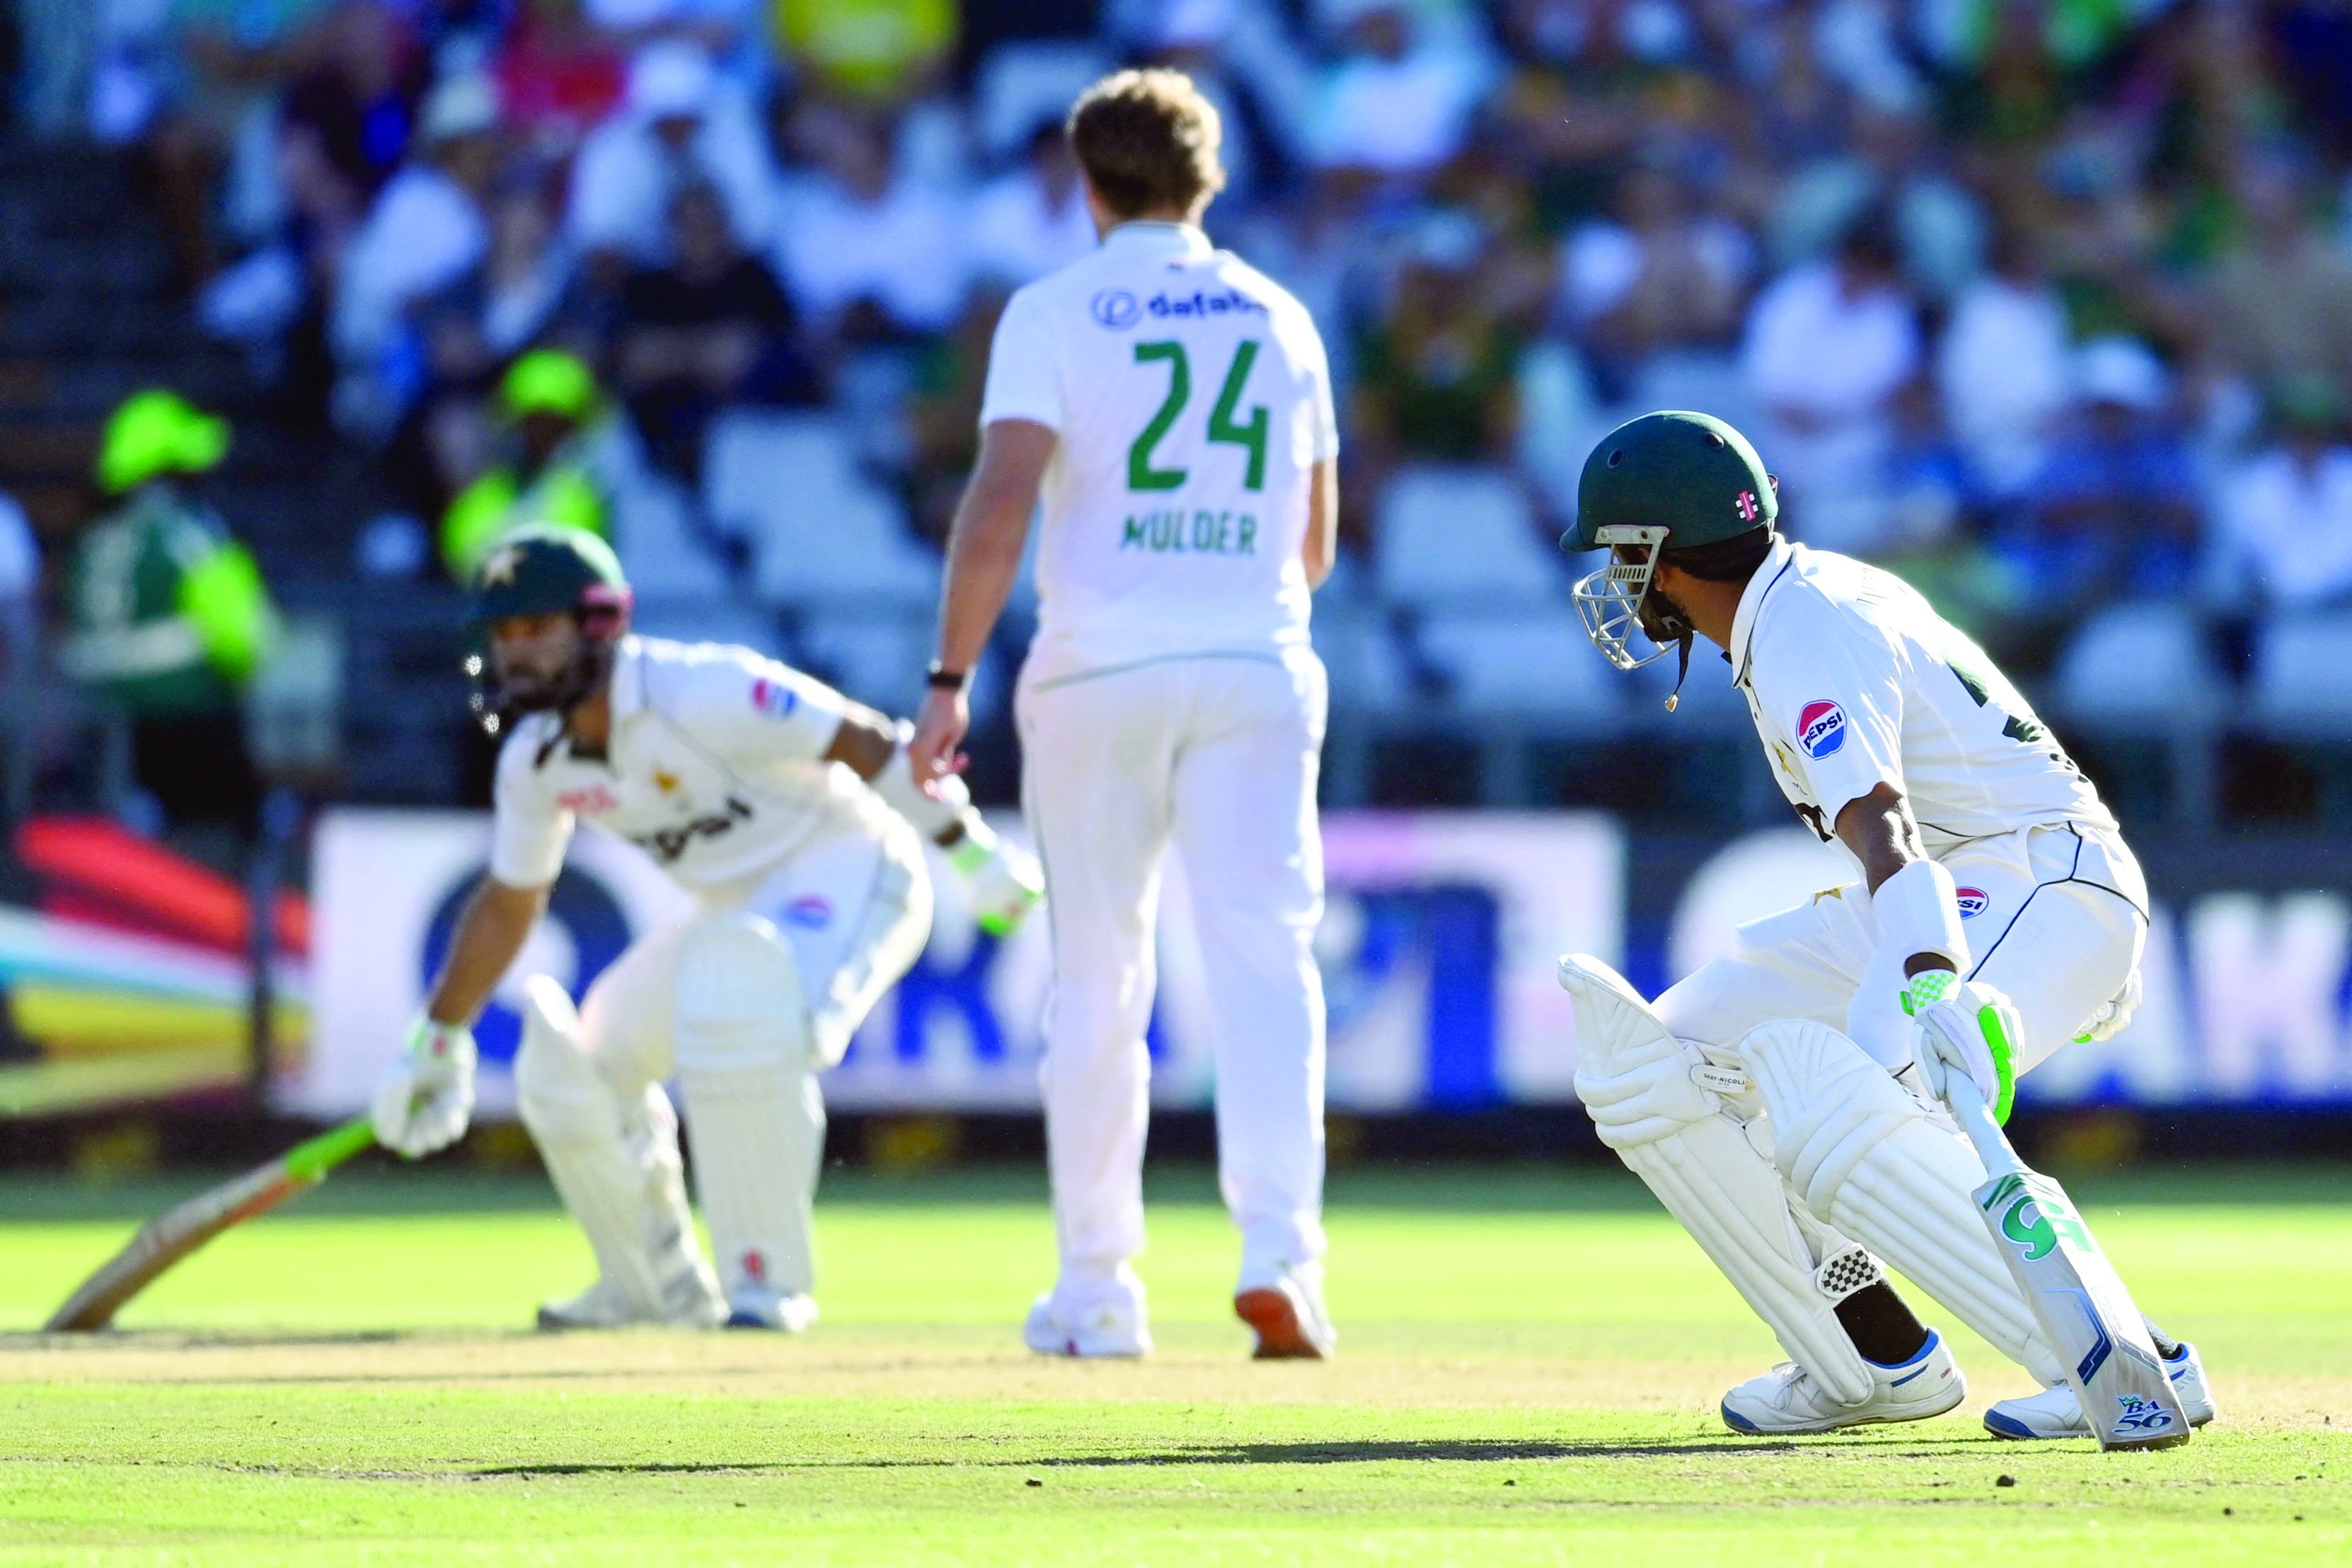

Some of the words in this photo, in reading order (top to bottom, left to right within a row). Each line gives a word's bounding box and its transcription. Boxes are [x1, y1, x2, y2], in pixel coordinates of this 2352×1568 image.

[1128, 340, 1269, 491] 24
[1120, 509, 1259, 555] MULDER
[1803, 711, 1843, 750] PEPSI
[2113, 1408, 2174, 1433] 56
[2126, 1400, 2160, 1414] BA
